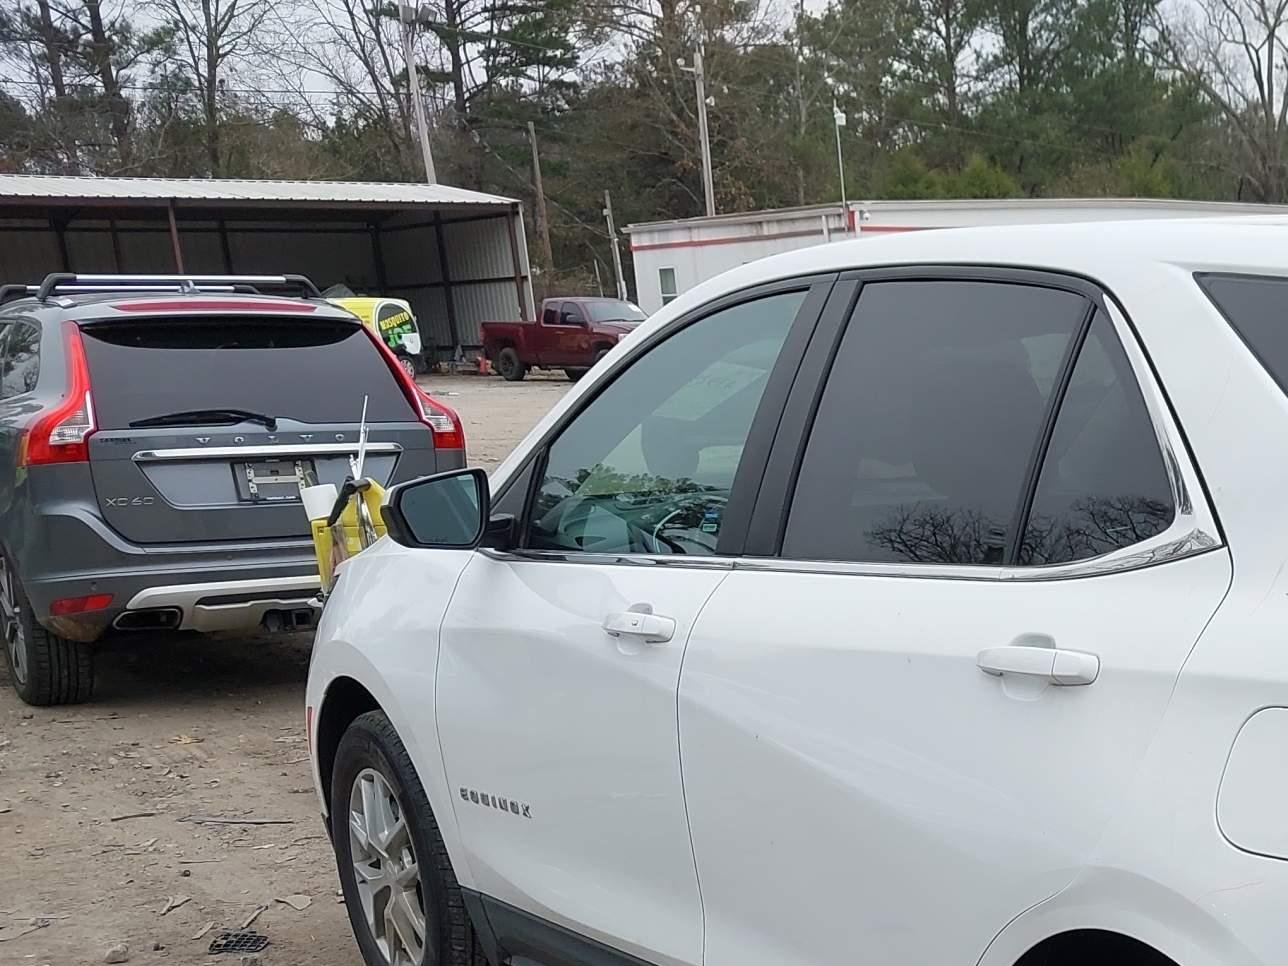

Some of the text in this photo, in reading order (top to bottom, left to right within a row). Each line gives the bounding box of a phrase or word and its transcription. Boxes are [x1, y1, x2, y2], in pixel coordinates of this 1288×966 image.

[195, 433, 345, 444] VOLVO
[106, 497, 154, 507] XC60
[460, 788, 532, 819] EQUINOX
